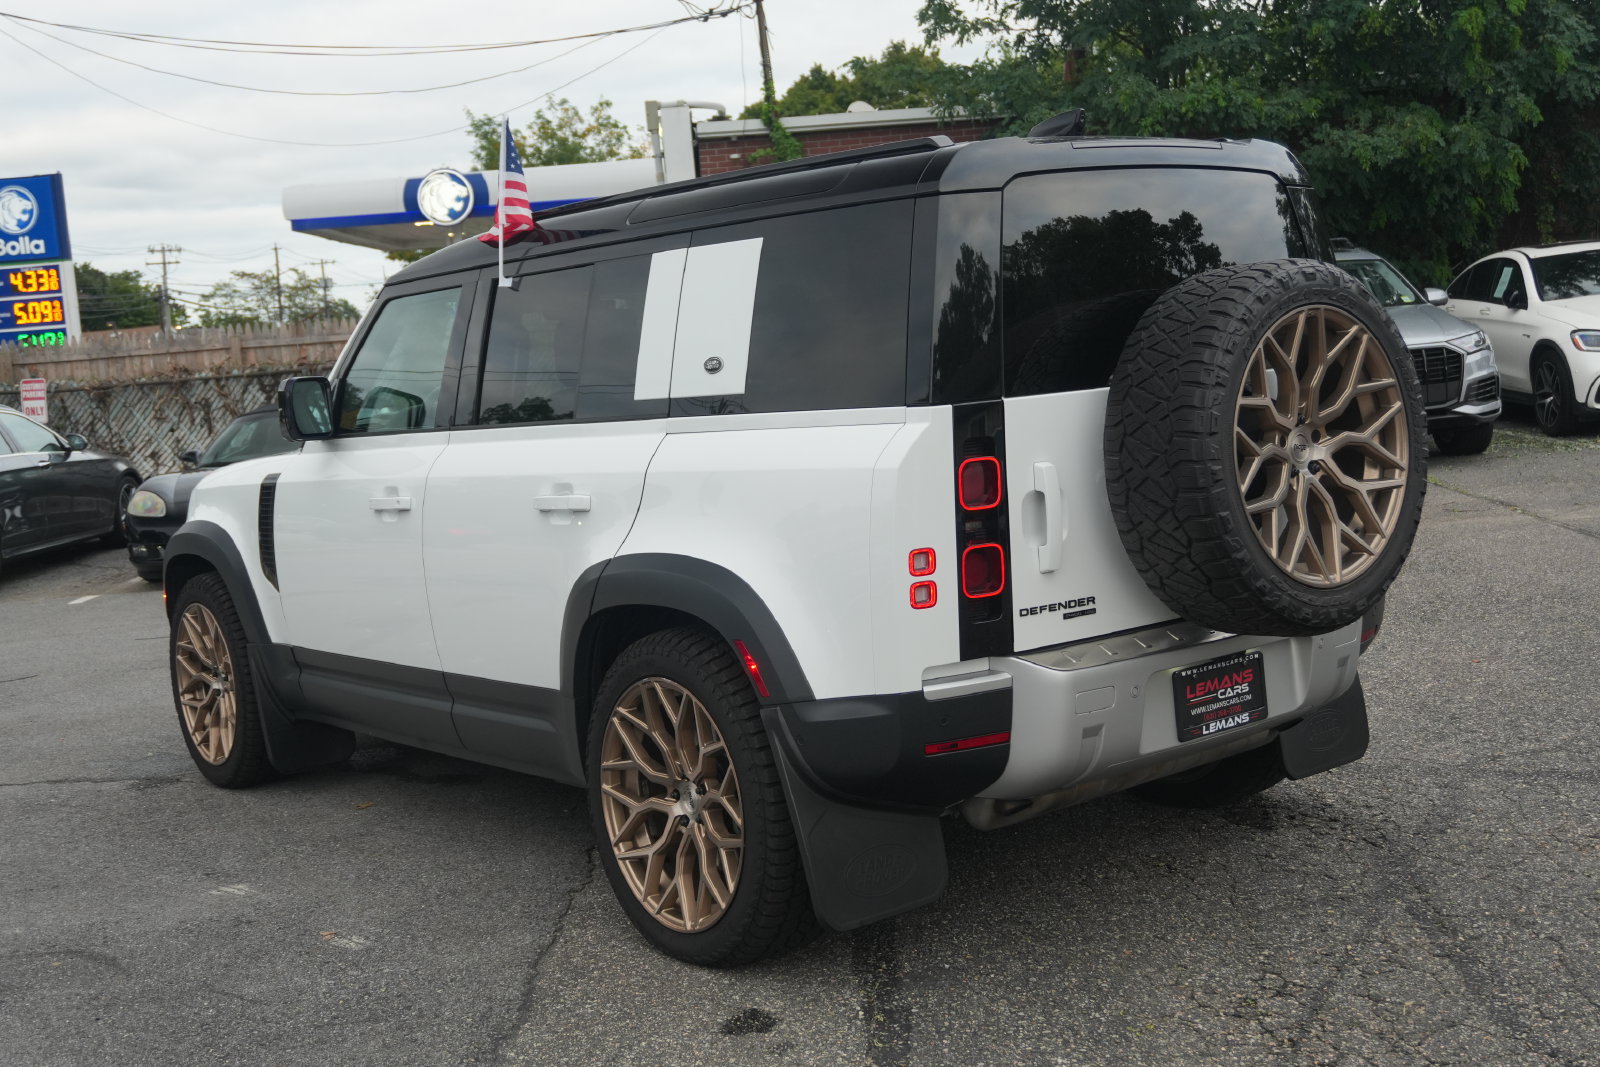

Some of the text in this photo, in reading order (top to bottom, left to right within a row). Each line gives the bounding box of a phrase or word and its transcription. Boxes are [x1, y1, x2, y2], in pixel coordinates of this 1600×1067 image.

[25, 406, 45, 416] ONLY
[1019, 596, 1096, 617] DEFENDER
[1181, 653, 1259, 677] WWW.LEMANSCARS.COM
[1186, 669, 1254, 699] LEMANS
[1217, 682, 1250, 699] CARS
[1190, 693, 1252, 716] WWW.LEMANSCARS.COM
[1202, 712, 1250, 735] LEMANS
